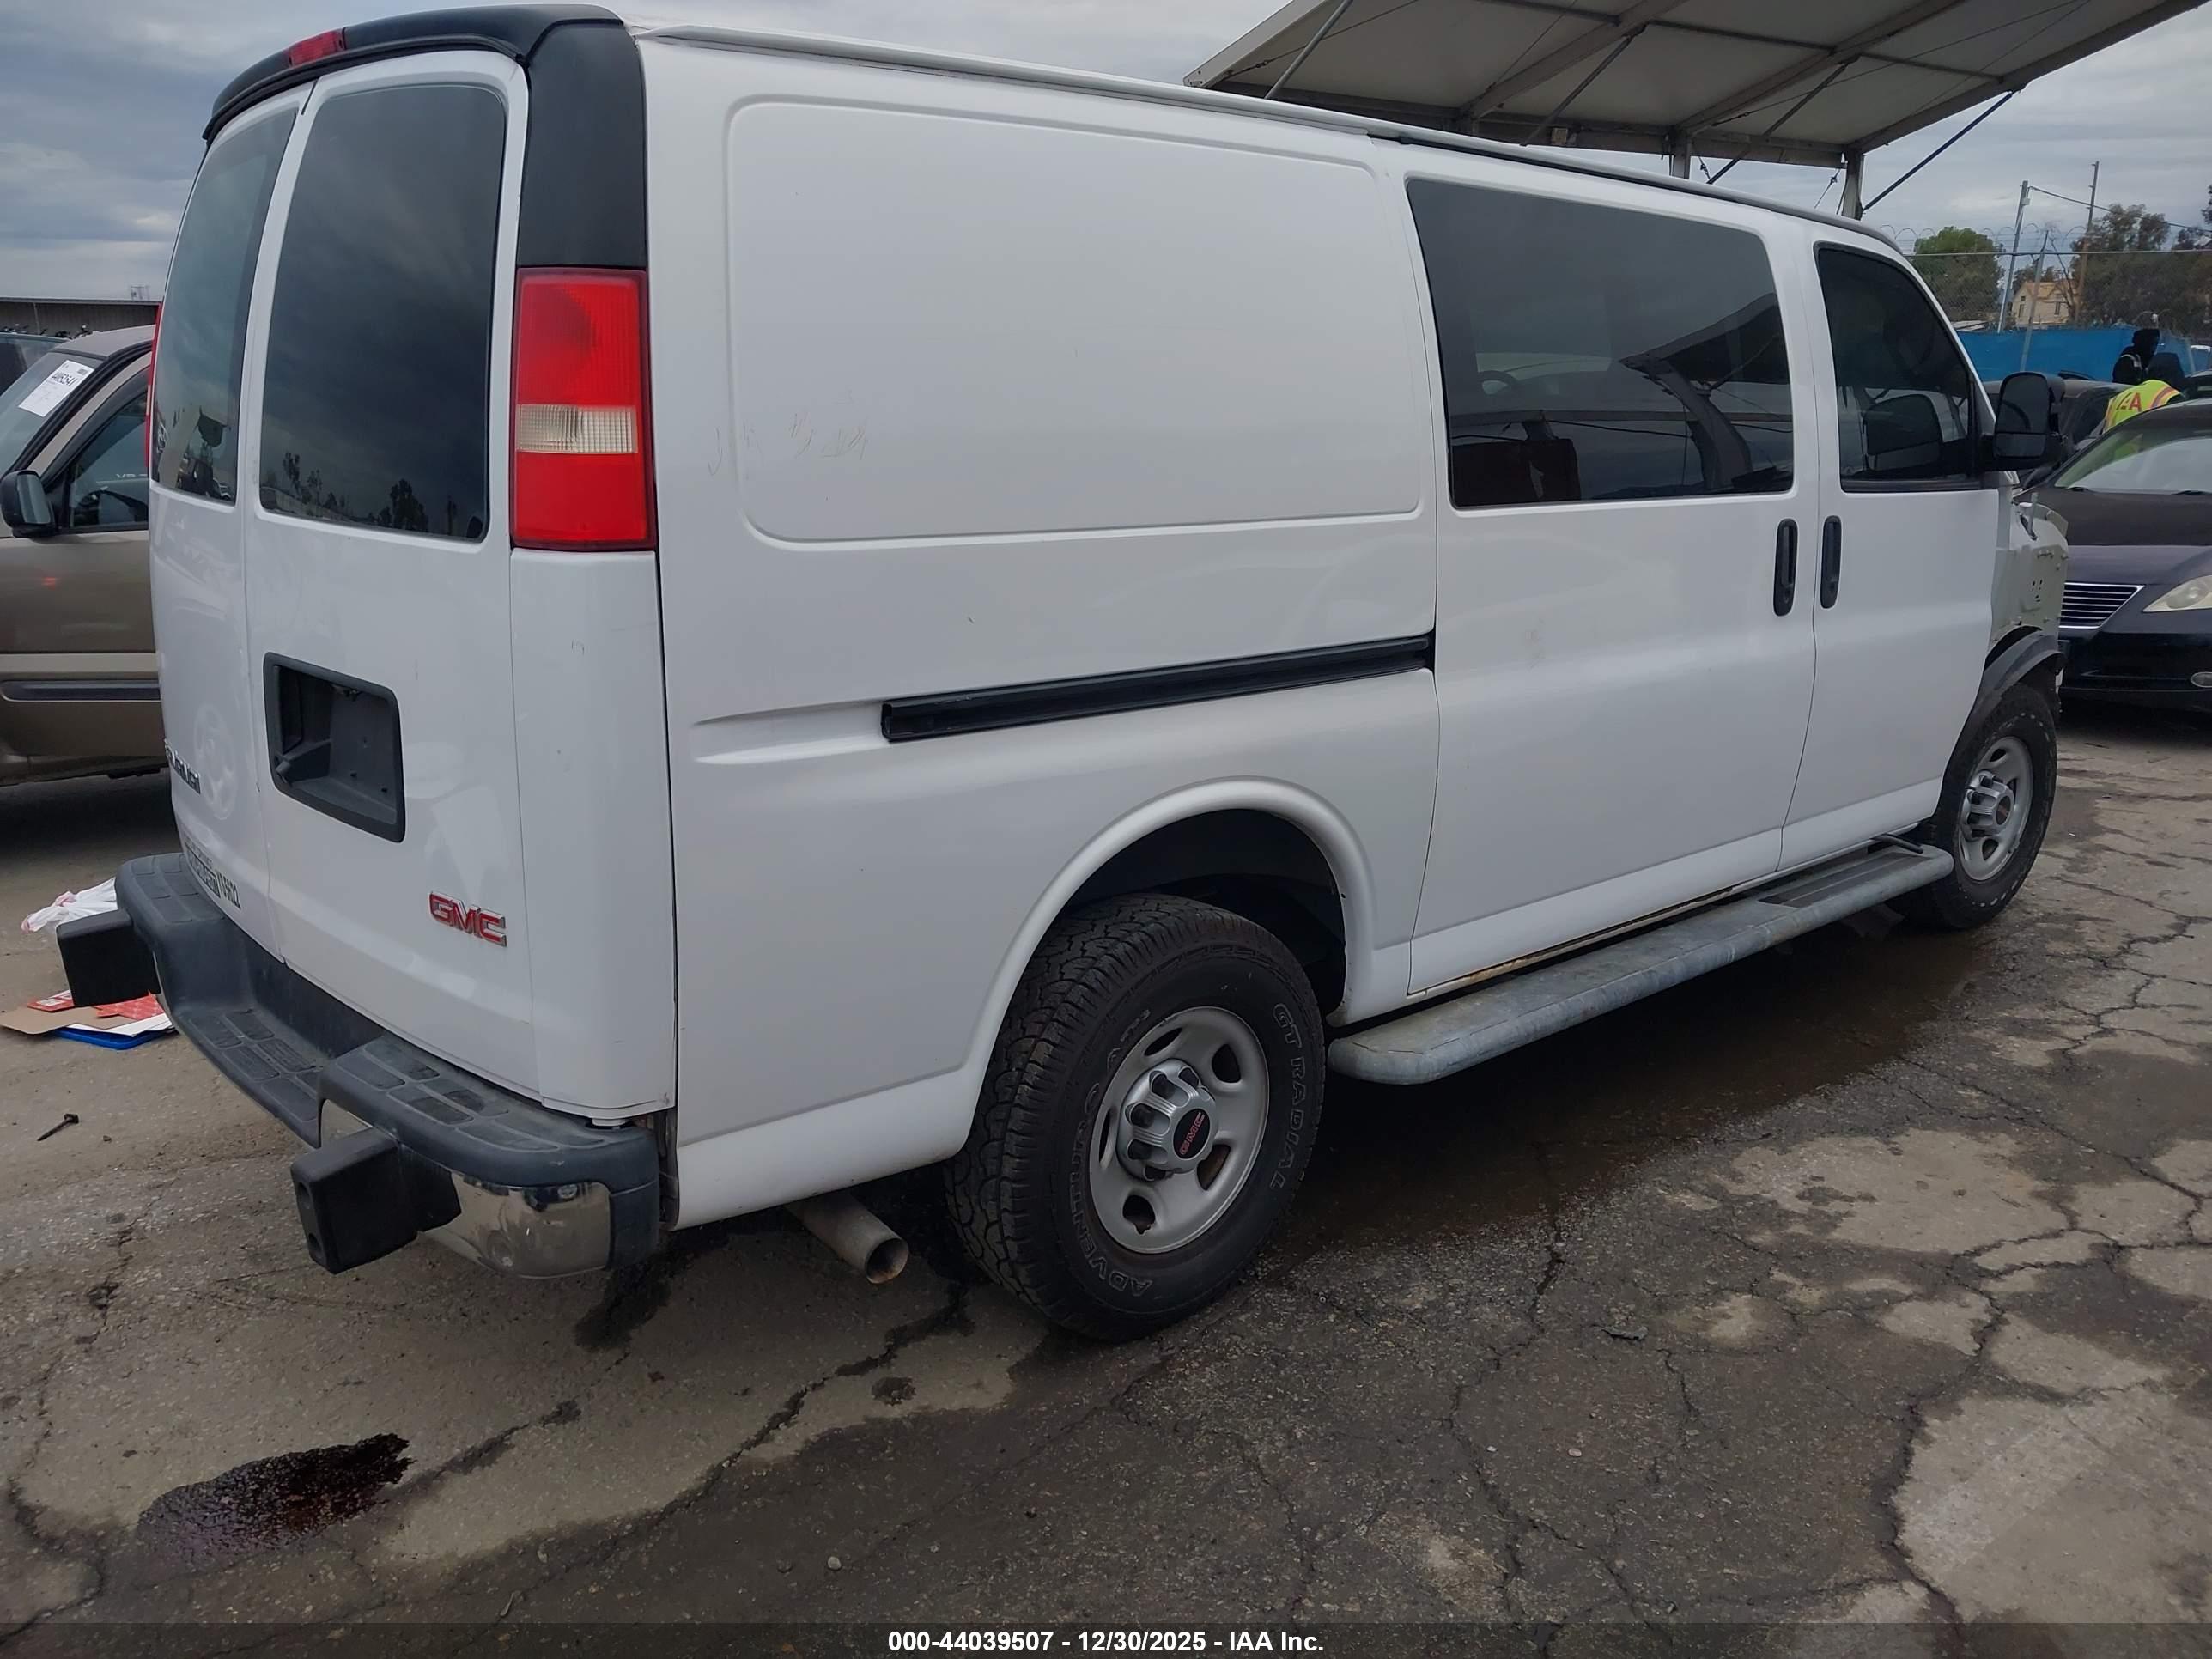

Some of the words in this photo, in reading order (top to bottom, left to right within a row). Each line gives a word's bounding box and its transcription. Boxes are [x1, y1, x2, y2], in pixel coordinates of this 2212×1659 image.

[428, 890, 507, 947] GMC
[1273, 1002, 1303, 1048] GT
[1179, 1111, 1206, 1156] GMC
[1269, 1056, 1306, 1189] RADIAL
